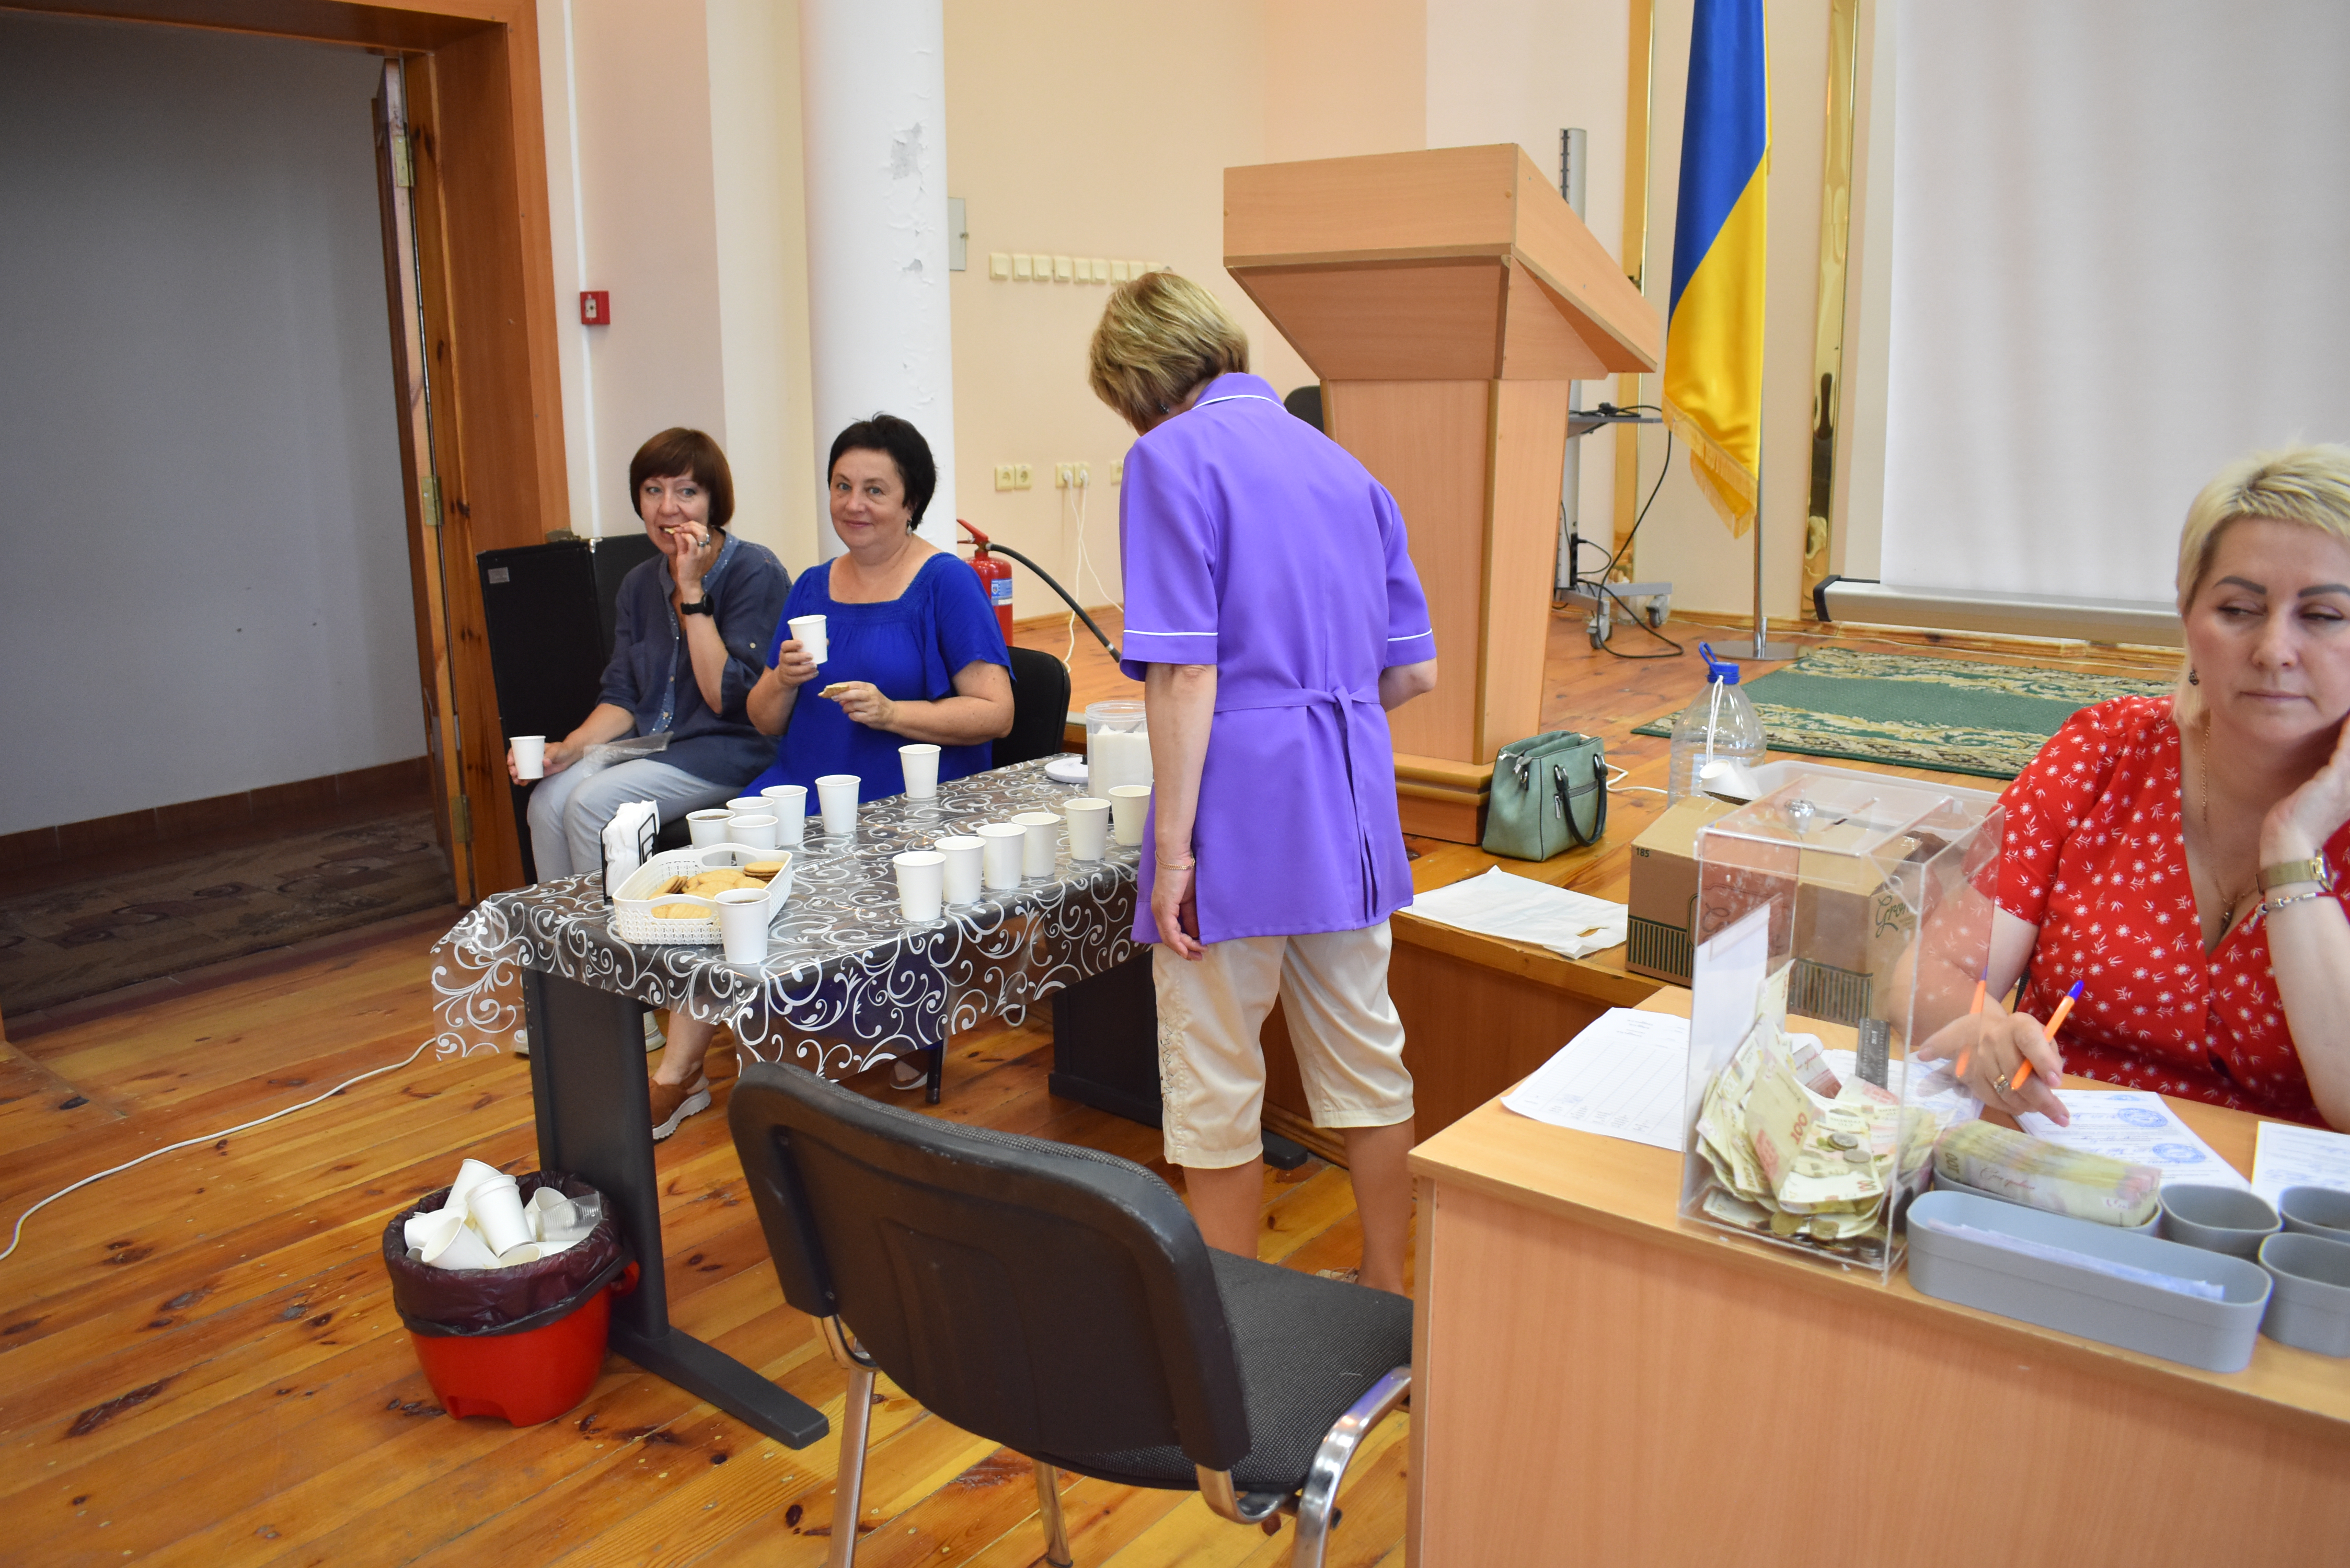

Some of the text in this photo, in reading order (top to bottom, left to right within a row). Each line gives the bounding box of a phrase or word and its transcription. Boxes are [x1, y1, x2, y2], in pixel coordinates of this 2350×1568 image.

[1636, 847, 1650, 858] 185
[1790, 1112, 1808, 1145] 100
[1944, 1152, 1960, 1174] 100
